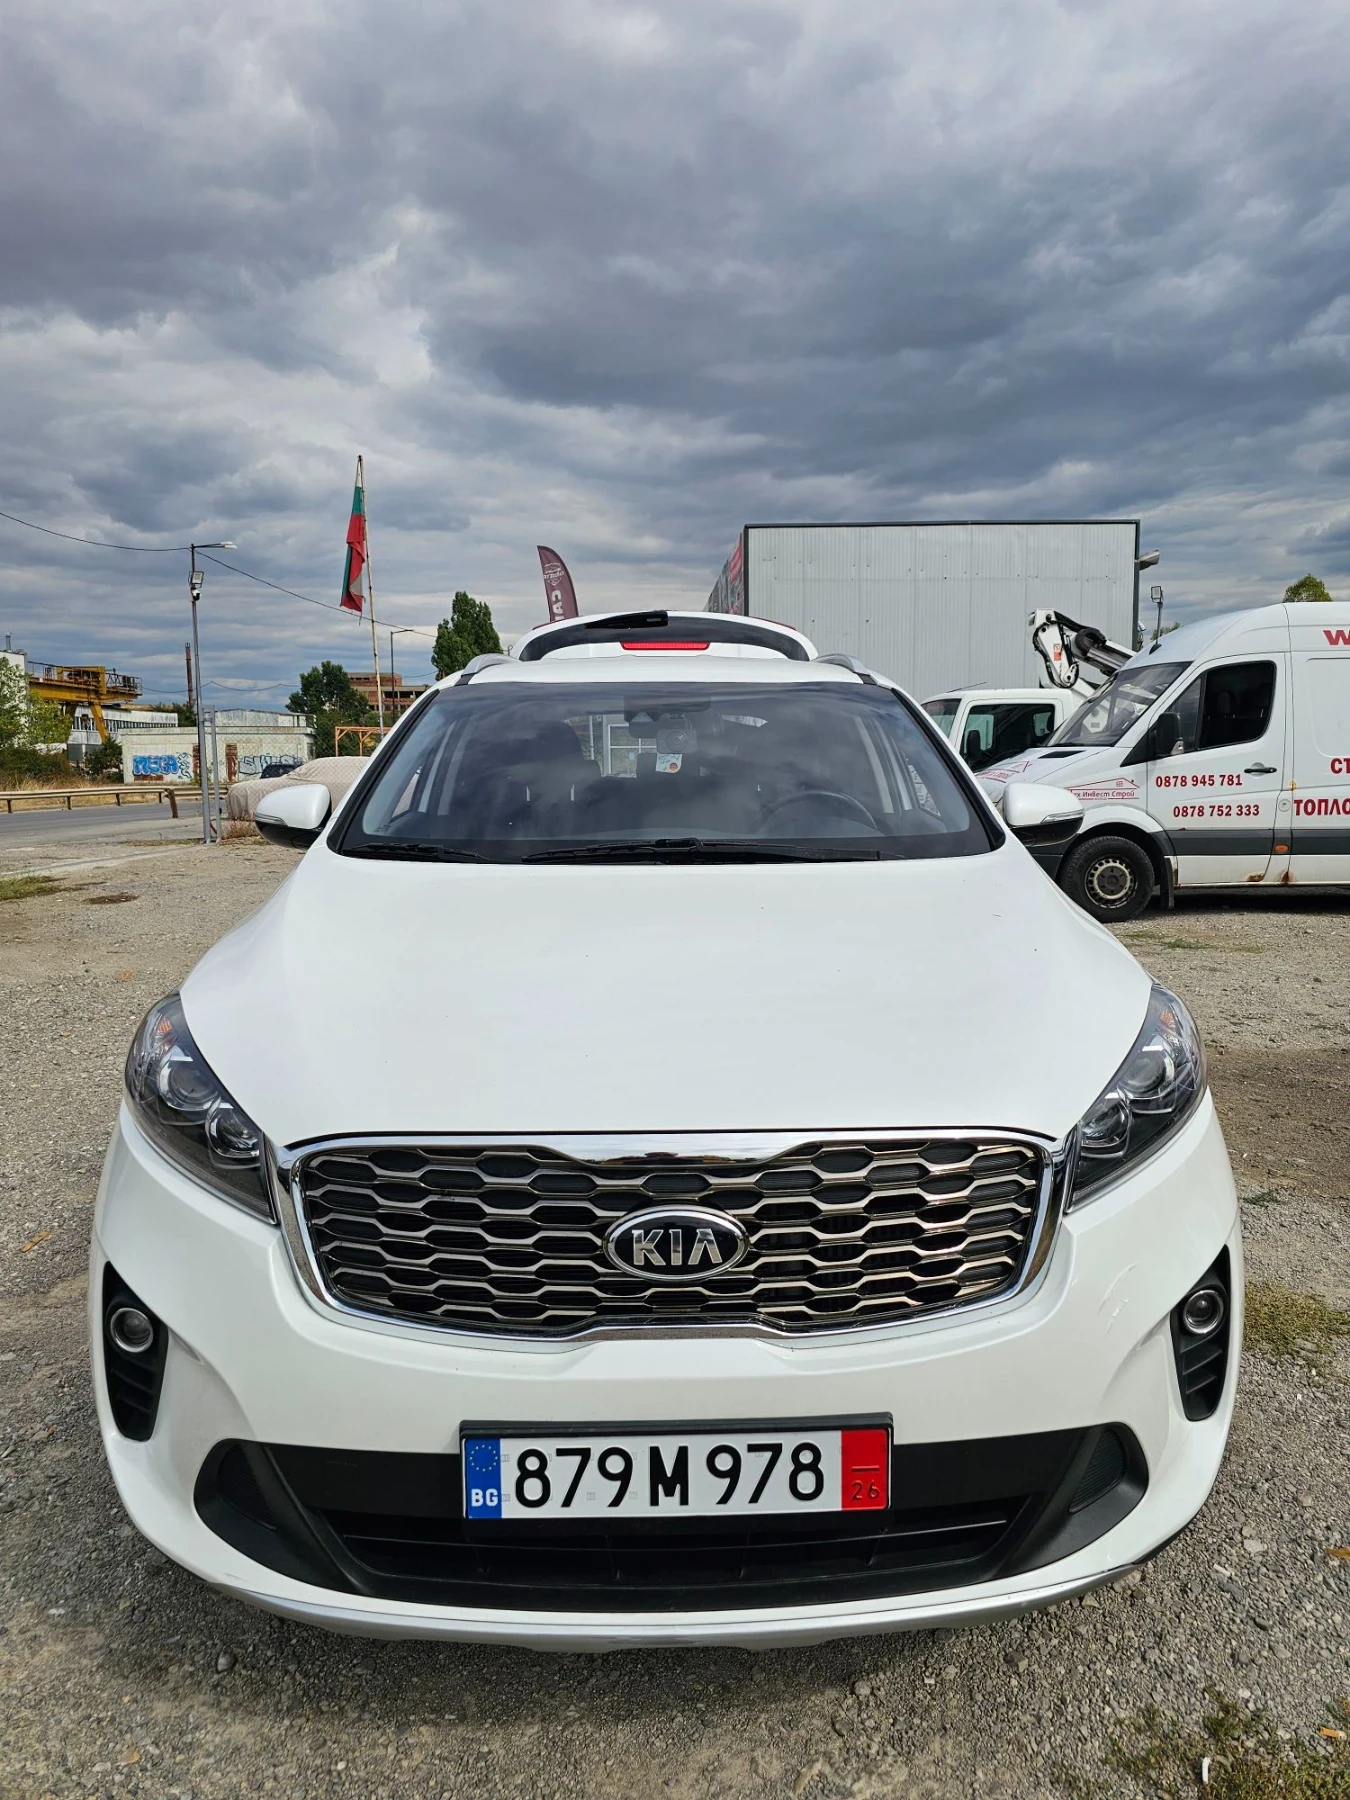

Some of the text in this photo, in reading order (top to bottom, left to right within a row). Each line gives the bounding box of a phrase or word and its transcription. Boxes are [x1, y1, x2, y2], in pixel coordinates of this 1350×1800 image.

[1156, 774, 1243, 787] 0878 945 781
[1173, 804, 1260, 818] 0878 752 333
[631, 1228, 723, 1266] KIA
[515, 1442, 824, 1508] 879 M 978
[471, 1488, 499, 1507] BG
[851, 1479, 880, 1501] 26
